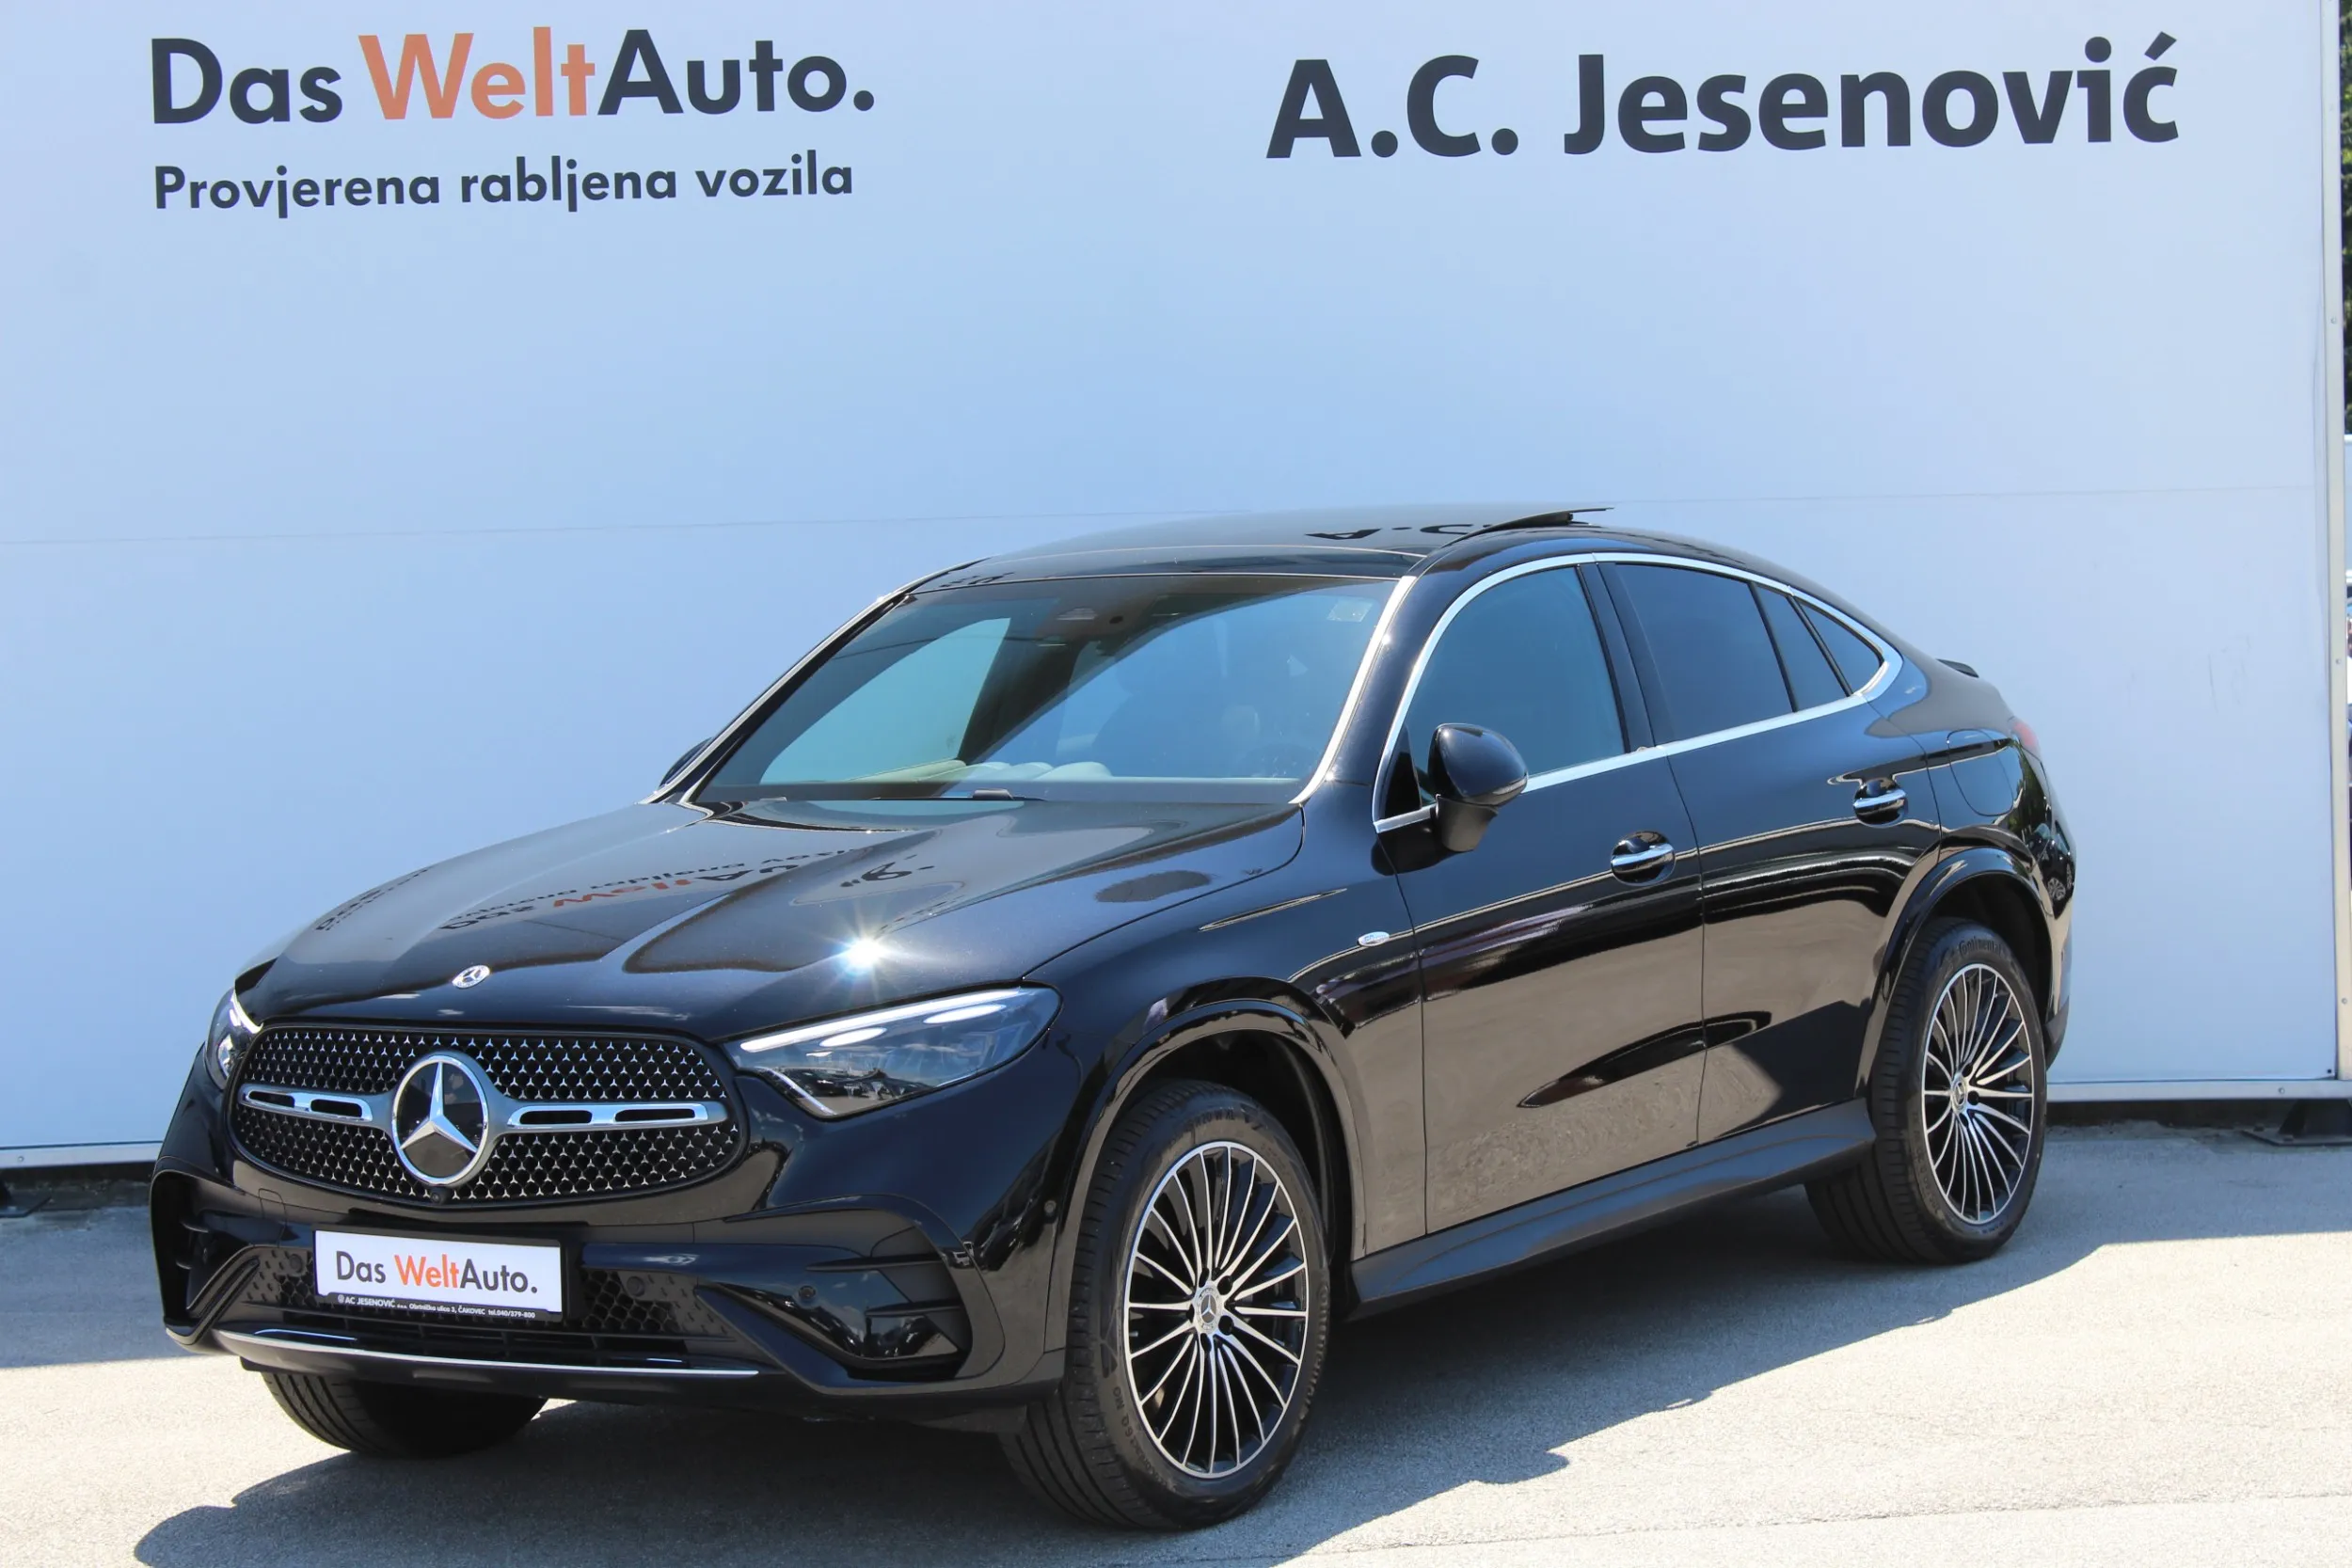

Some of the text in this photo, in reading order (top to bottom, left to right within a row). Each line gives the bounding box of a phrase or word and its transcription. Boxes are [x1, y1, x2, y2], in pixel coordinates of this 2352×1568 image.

[151, 25, 876, 124] Das WeltAuto.
[1265, 31, 2180, 159] A.C. Jesenović
[154, 149, 853, 219] Provjerena rabljena vozila
[336, 1250, 539, 1294] Das WeltAuto.
[357, 1297, 396, 1308] JESENOVIĆ
[458, 1305, 485, 1315] ČAKOVEC
